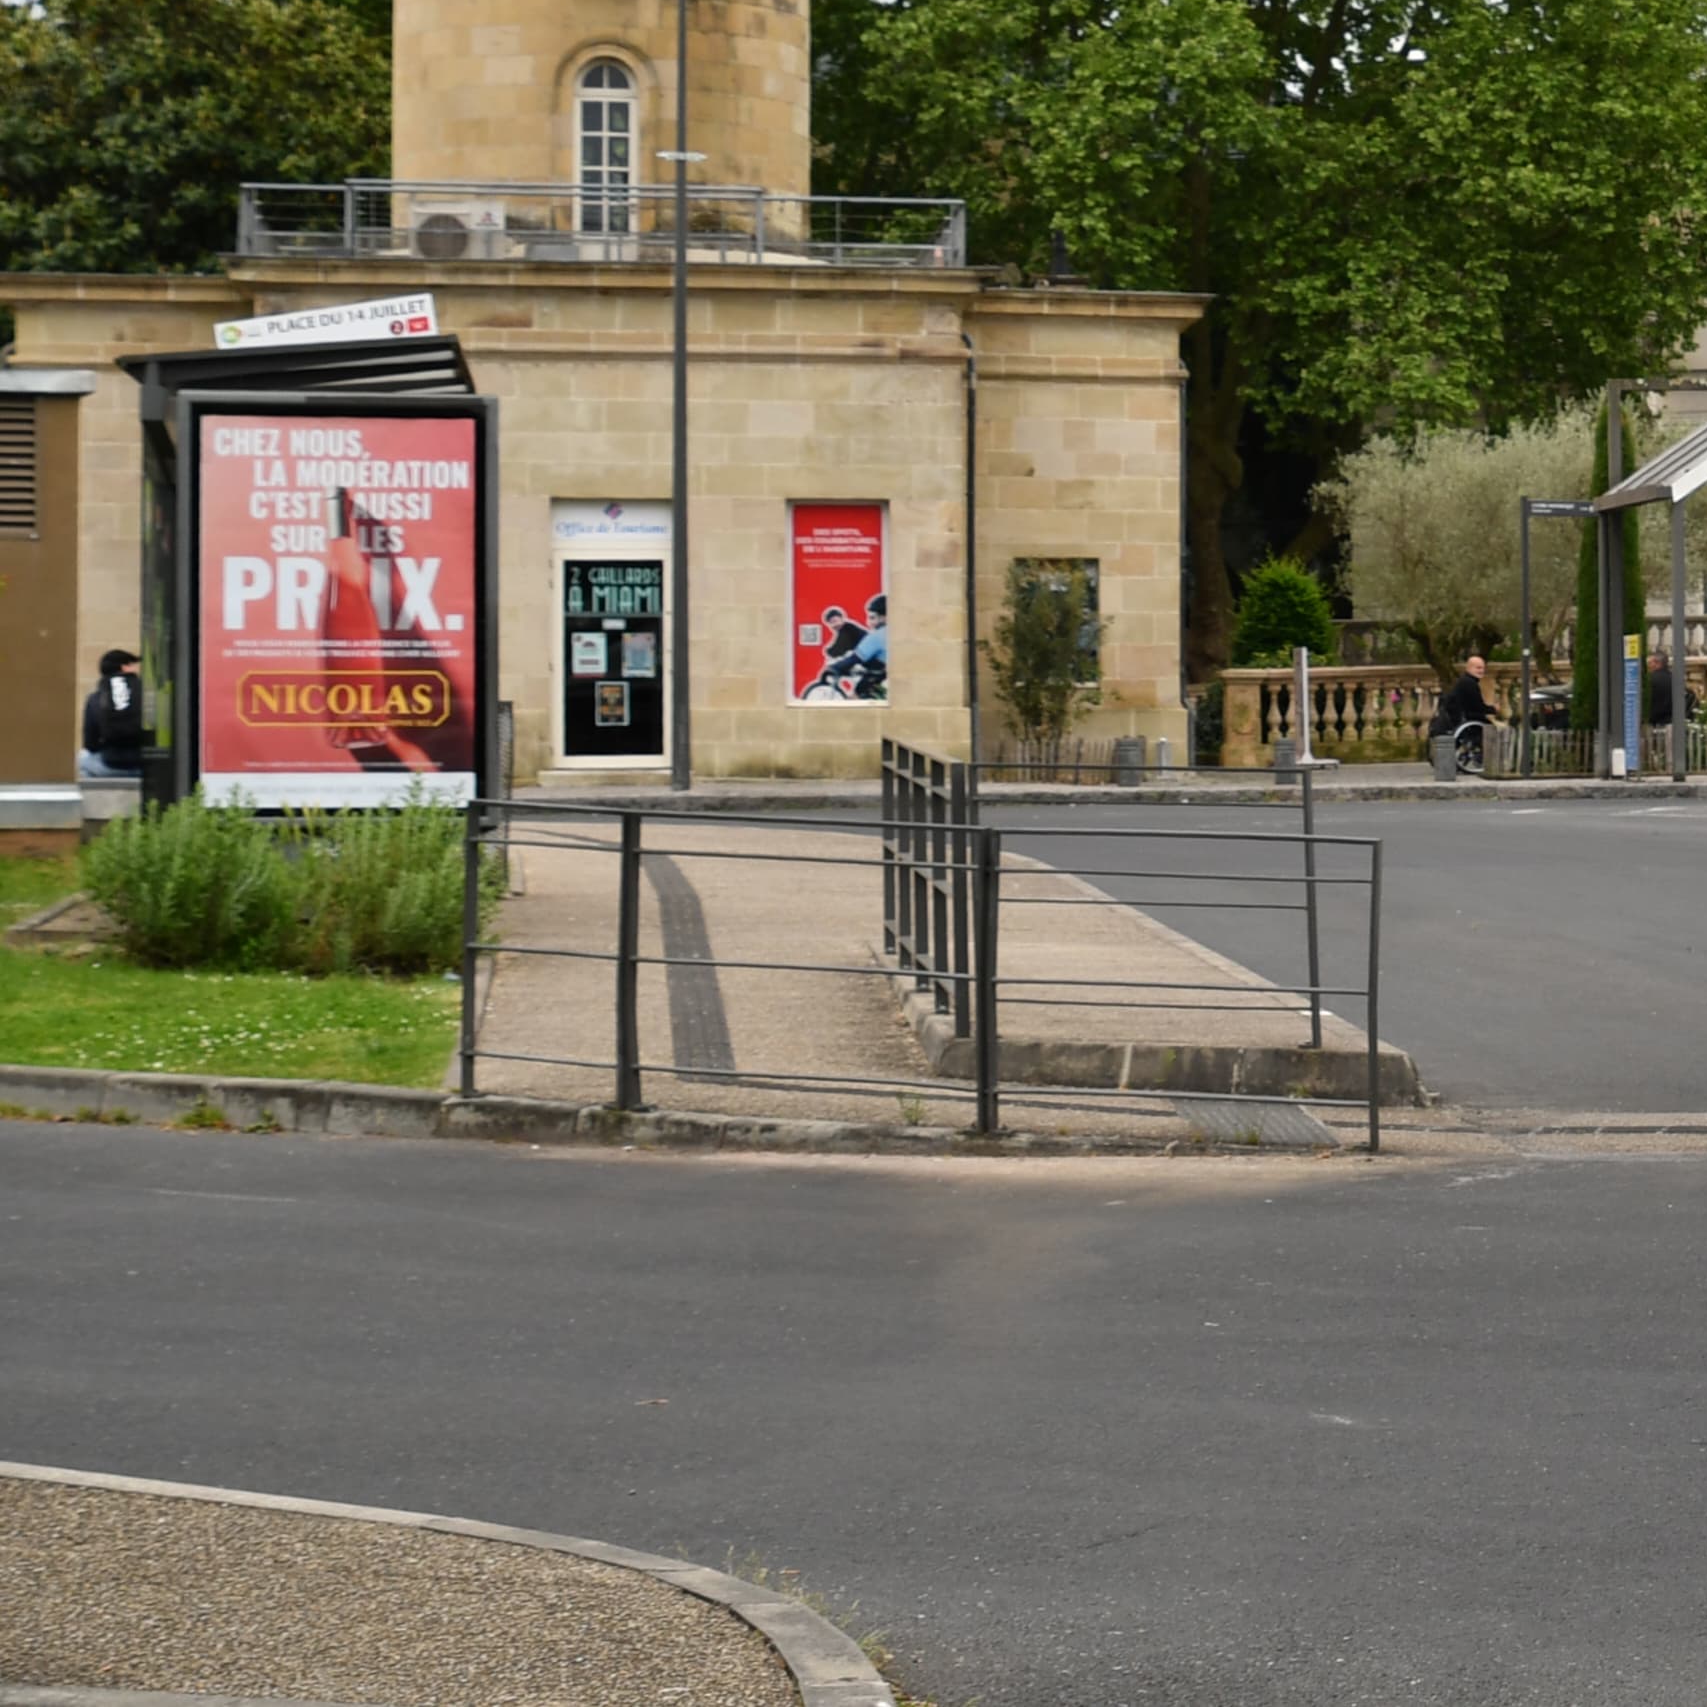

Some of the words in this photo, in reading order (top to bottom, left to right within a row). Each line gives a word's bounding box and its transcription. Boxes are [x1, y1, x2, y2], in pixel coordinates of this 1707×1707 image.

[267, 315, 316, 334] PLACE
[319, 311, 342, 327] DU
[349, 309, 364, 322] 14
[370, 299, 425, 320] JUILLET
[213, 428, 281, 456] CHEZ
[289, 430, 370, 458] NOUS,
[253, 460, 287, 486] LA
[296, 452, 469, 488] MODÉRATION
[250, 491, 321, 520] C'EST
[352, 492, 432, 520] AUSSI
[271, 525, 327, 553] SUR
[359, 525, 405, 553] LES
[570, 566, 581, 584] 2
[587, 566, 661, 585] GAILLARDS
[222, 556, 464, 631] PRIX.
[592, 585, 660, 614] MIAMI
[249, 683, 434, 715] NICOLAS
